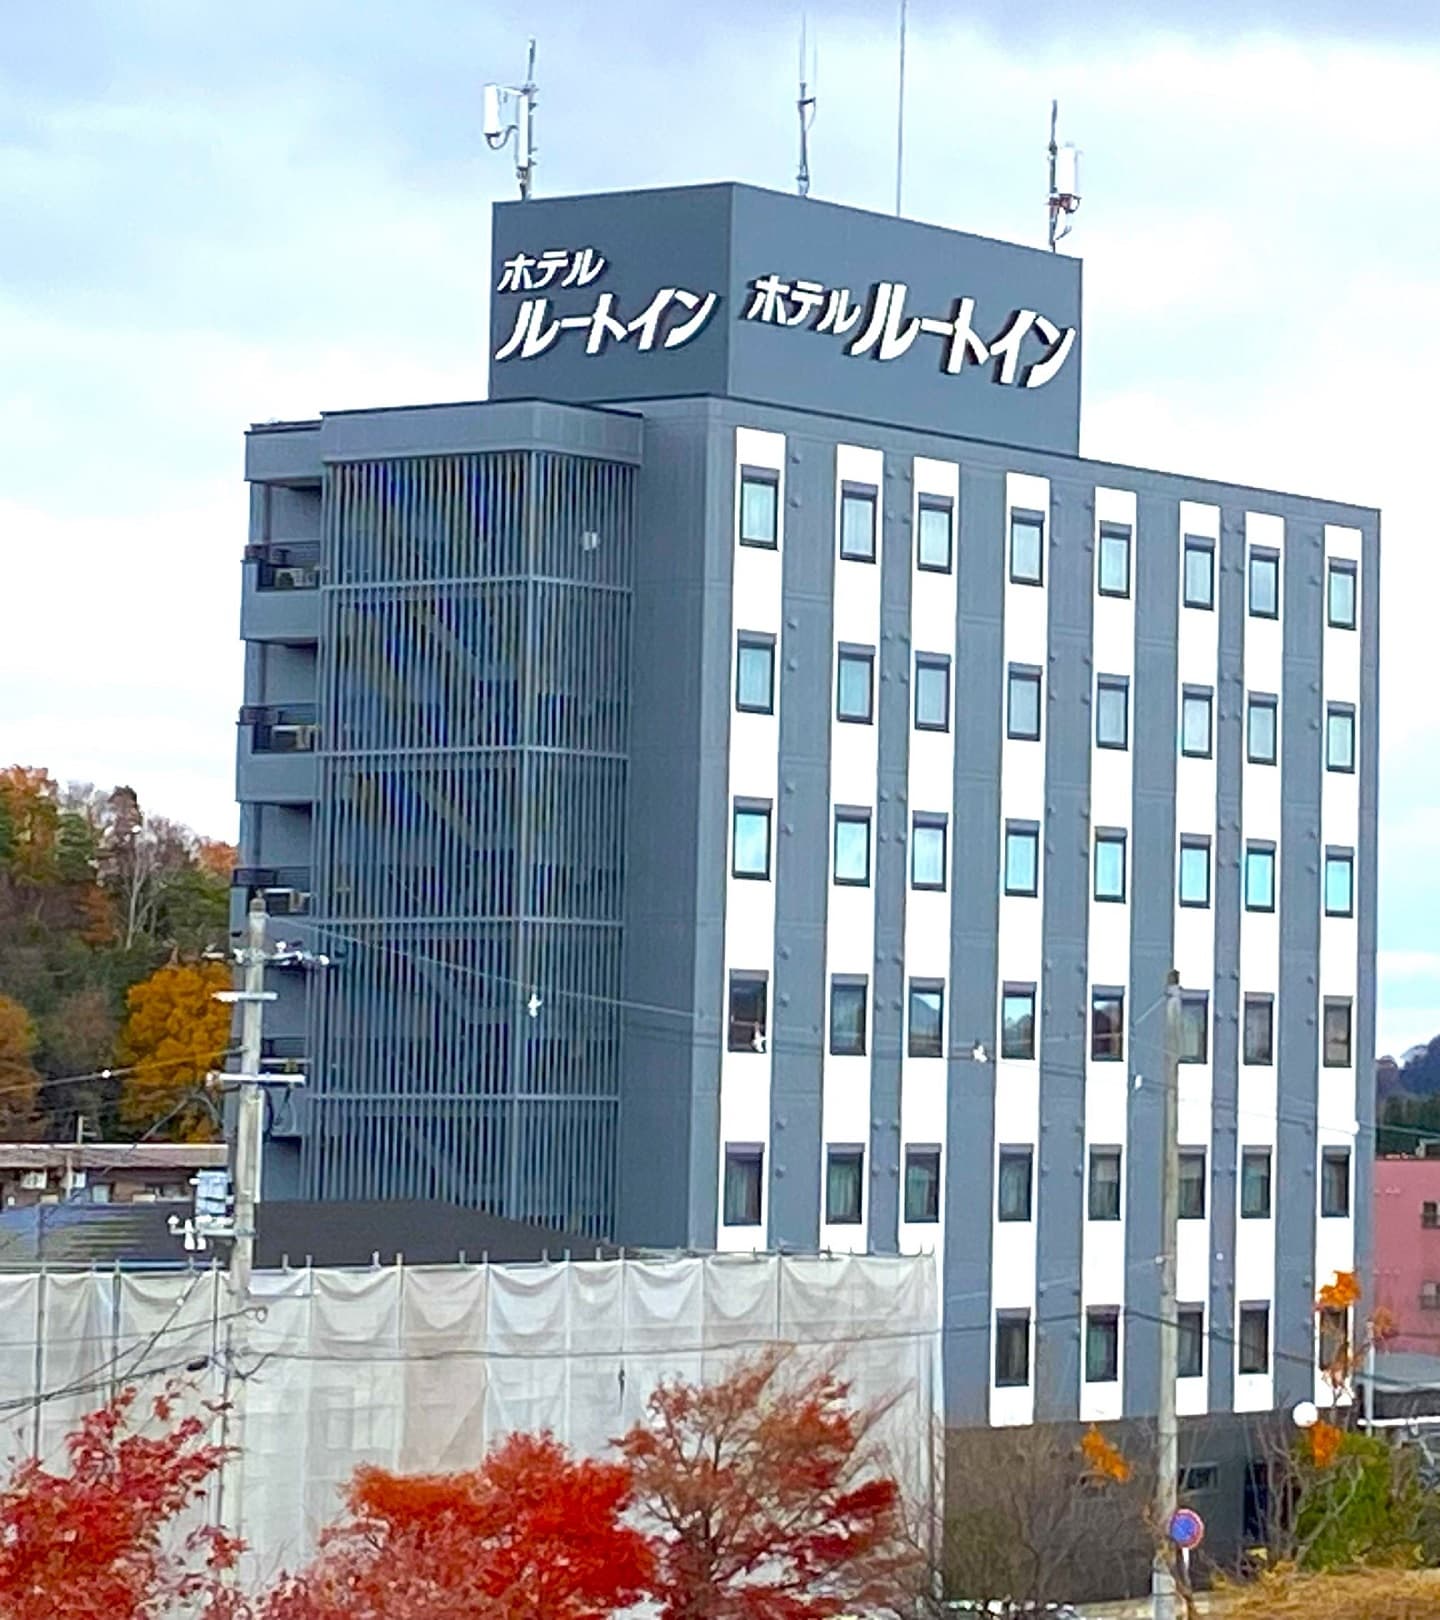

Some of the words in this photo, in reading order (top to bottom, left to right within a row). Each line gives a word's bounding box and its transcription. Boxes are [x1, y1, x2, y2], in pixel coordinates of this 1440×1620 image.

[497, 249, 605, 291] ホテル
[495, 289, 716, 360] ルートイン
[747, 275, 1076, 388] ホテルルートイン
